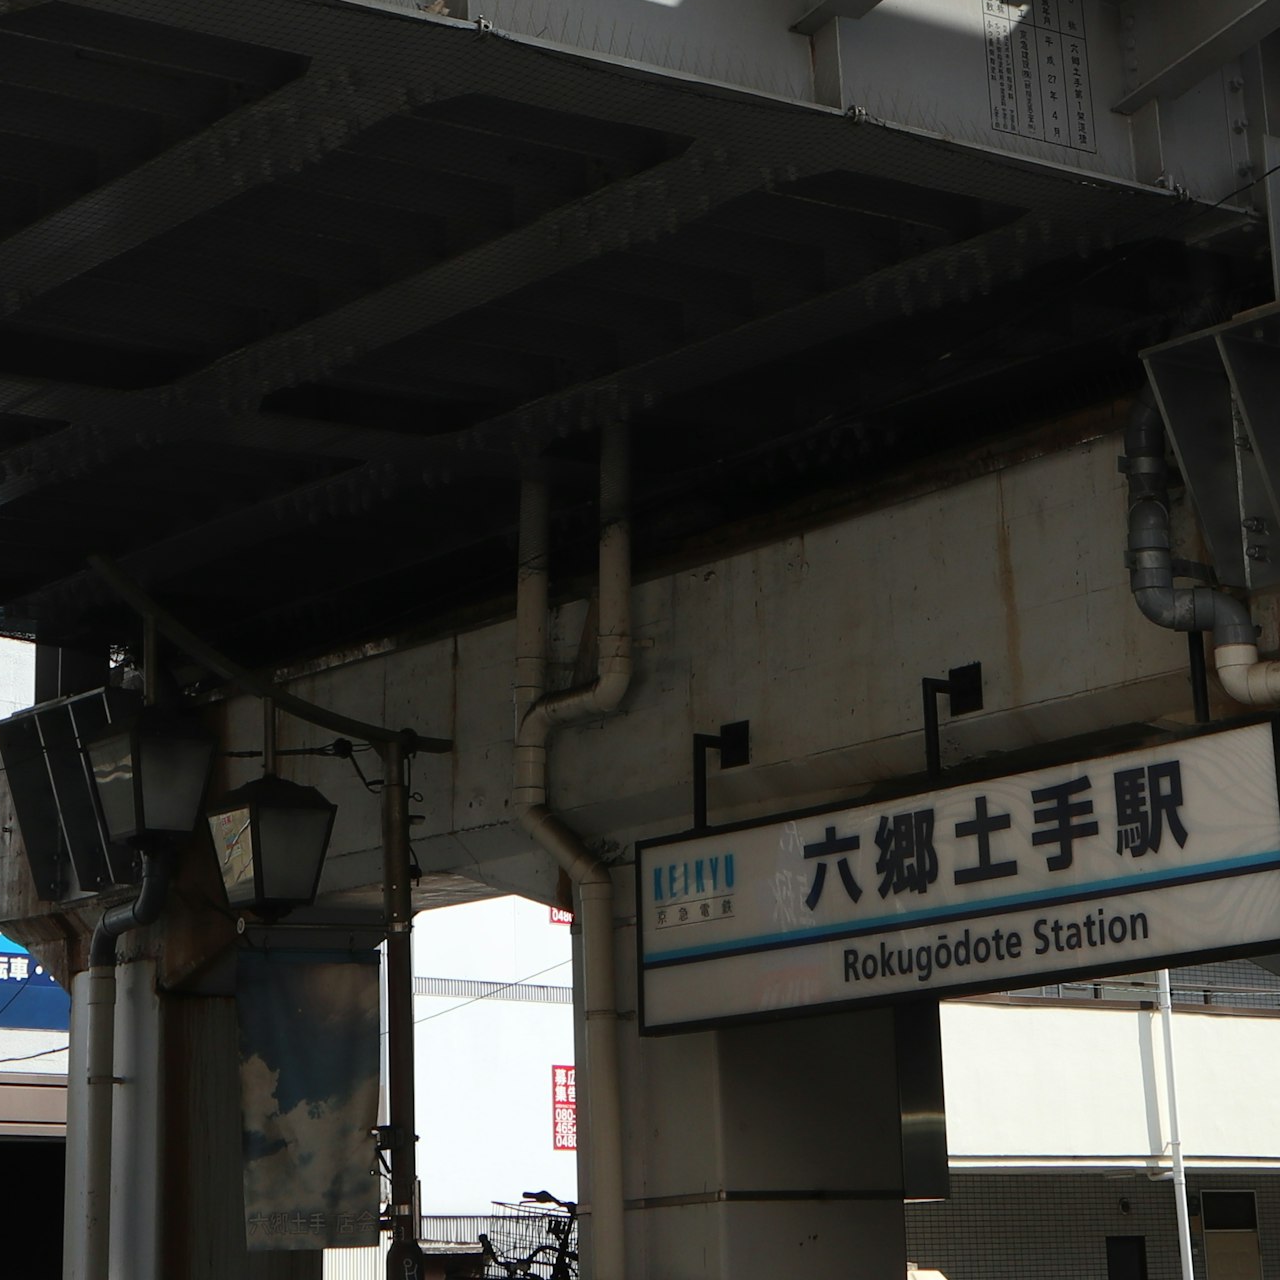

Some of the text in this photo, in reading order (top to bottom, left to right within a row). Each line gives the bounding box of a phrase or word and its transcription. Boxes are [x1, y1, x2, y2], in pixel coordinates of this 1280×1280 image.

[802, 759, 1189, 914] 六郷土手駅
[653, 852, 736, 902] KEIKYU
[656, 894, 735, 930] 京急電鉄
[843, 908, 1149, 984] Rokugōdote Station
